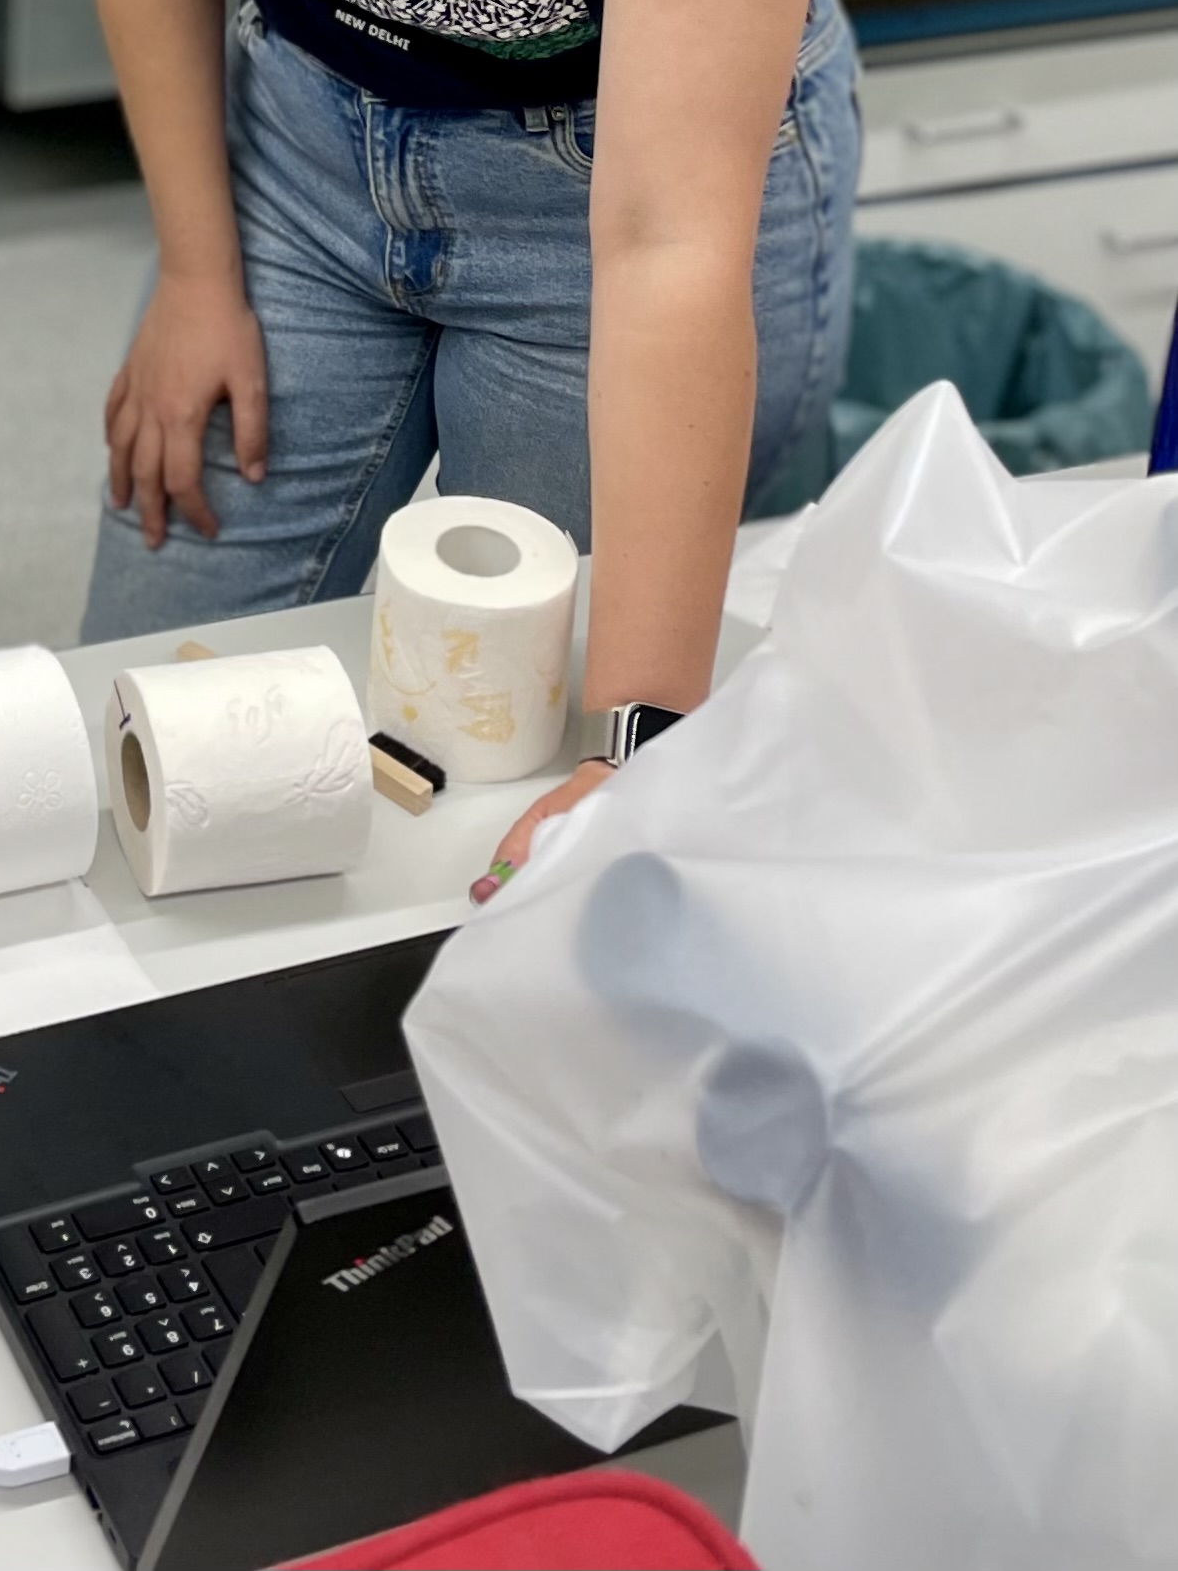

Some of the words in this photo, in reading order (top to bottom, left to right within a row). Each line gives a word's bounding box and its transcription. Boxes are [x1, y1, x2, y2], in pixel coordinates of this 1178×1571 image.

[334, 8, 367, 32] NEW
[367, 23, 412, 52] DELHI
[321, 1214, 454, 1292] ThinkPad
